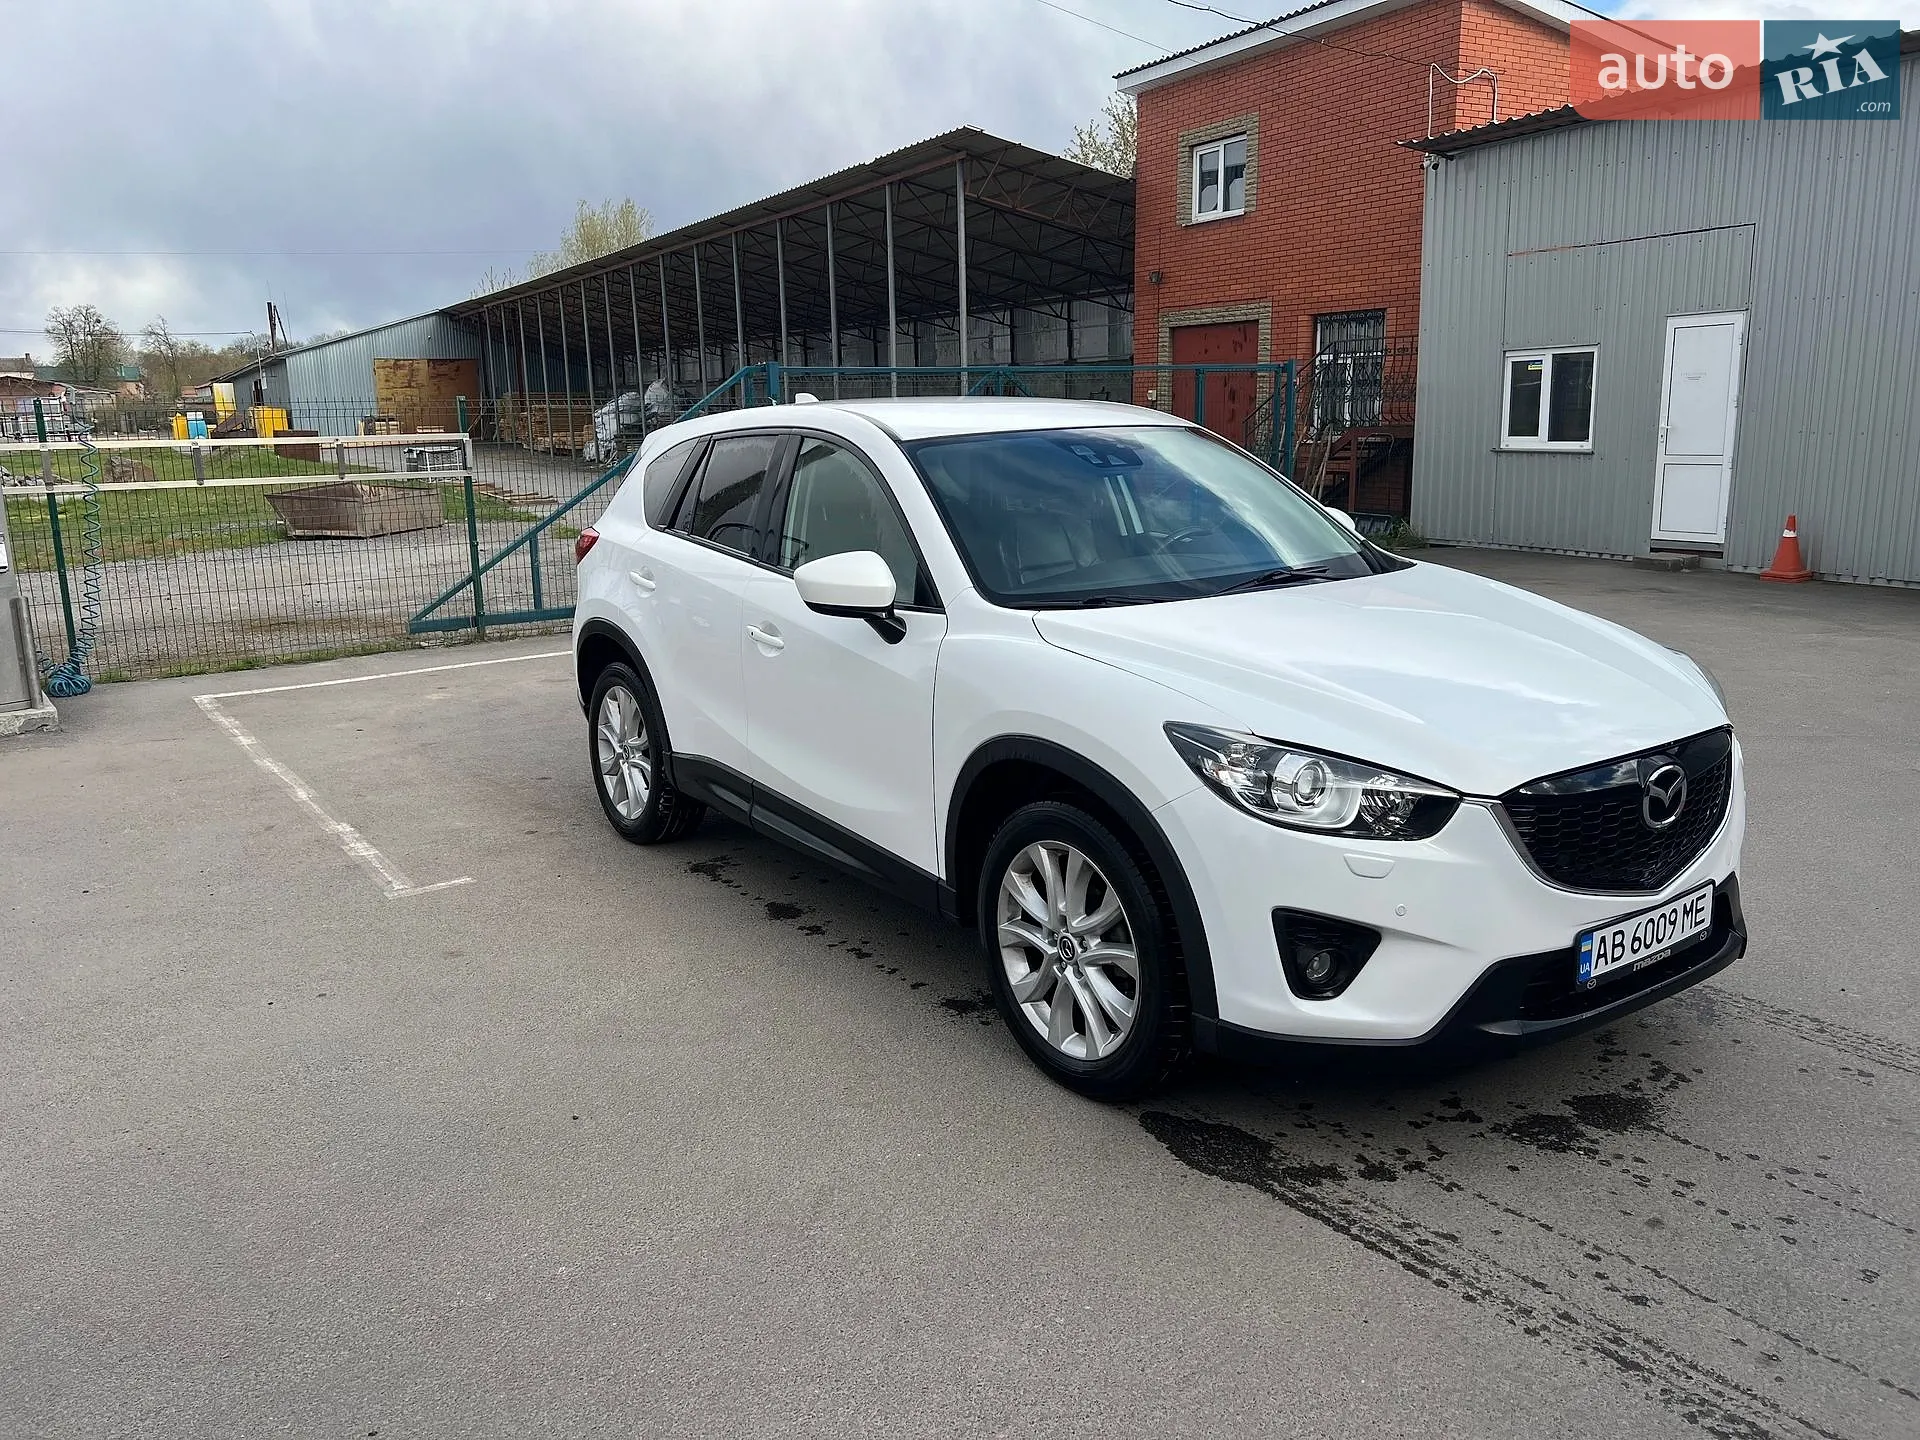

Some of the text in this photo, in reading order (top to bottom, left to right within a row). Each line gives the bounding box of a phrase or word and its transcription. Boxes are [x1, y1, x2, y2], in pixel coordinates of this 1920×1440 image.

[1594, 892, 1707, 970] AB 6009 ME
[1580, 962, 1591, 974] UA
